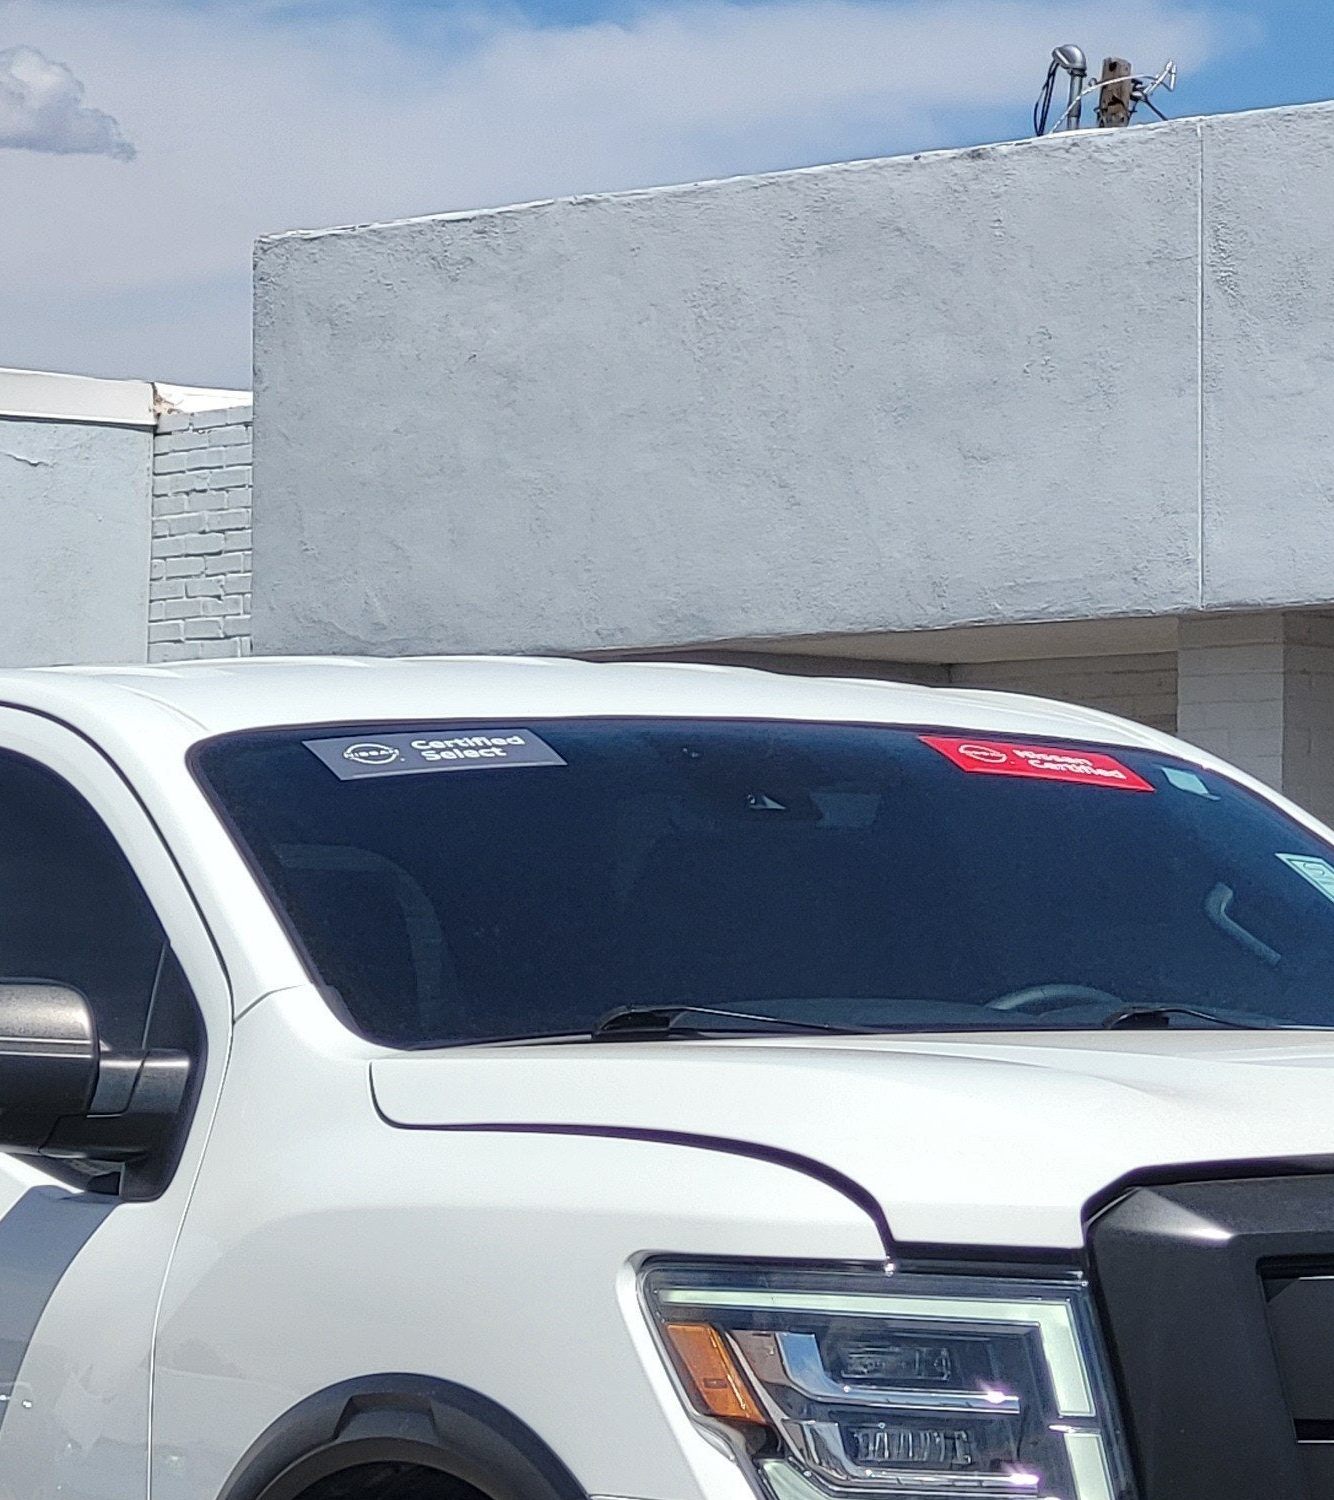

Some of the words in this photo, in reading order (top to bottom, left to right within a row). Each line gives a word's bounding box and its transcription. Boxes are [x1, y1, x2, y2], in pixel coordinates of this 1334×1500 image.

[411, 736, 526, 750] Certified
[421, 747, 507, 761] Select
[1028, 759, 1127, 780] Certified
